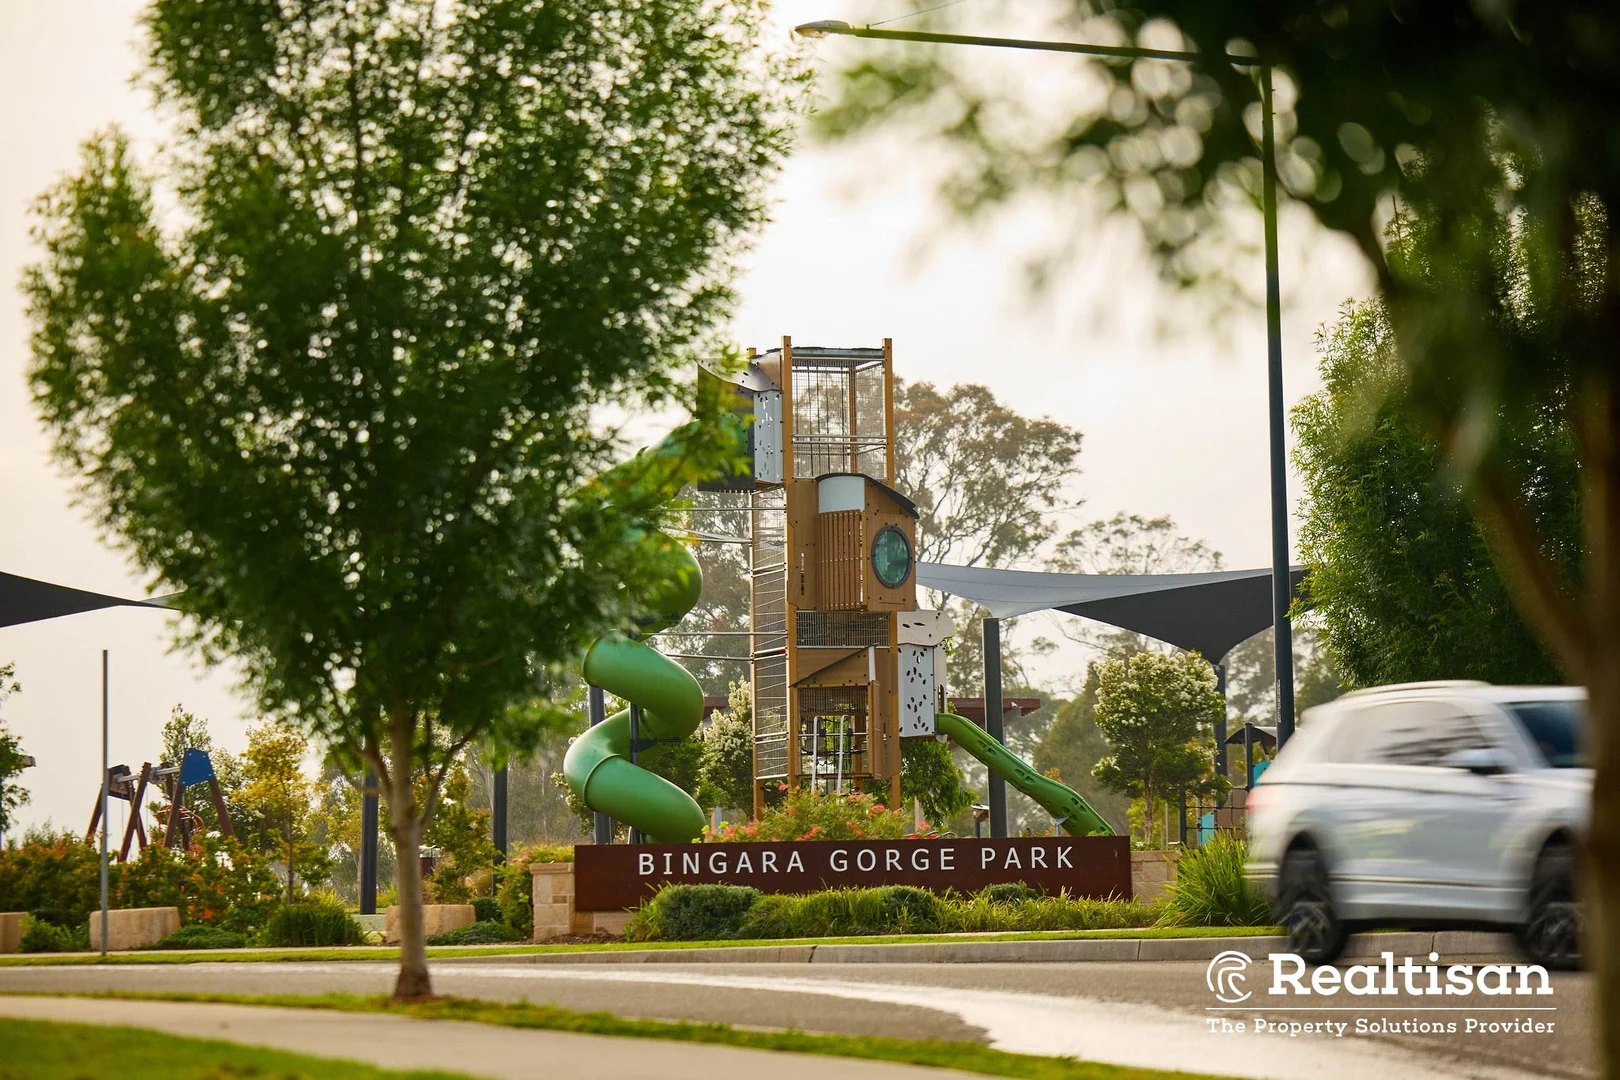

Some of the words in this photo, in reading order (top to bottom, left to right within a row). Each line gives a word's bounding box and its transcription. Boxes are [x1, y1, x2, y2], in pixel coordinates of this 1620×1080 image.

[637, 851, 806, 876] BINGARA
[828, 847, 957, 873] GORGE
[980, 845, 1076, 870] PARK
